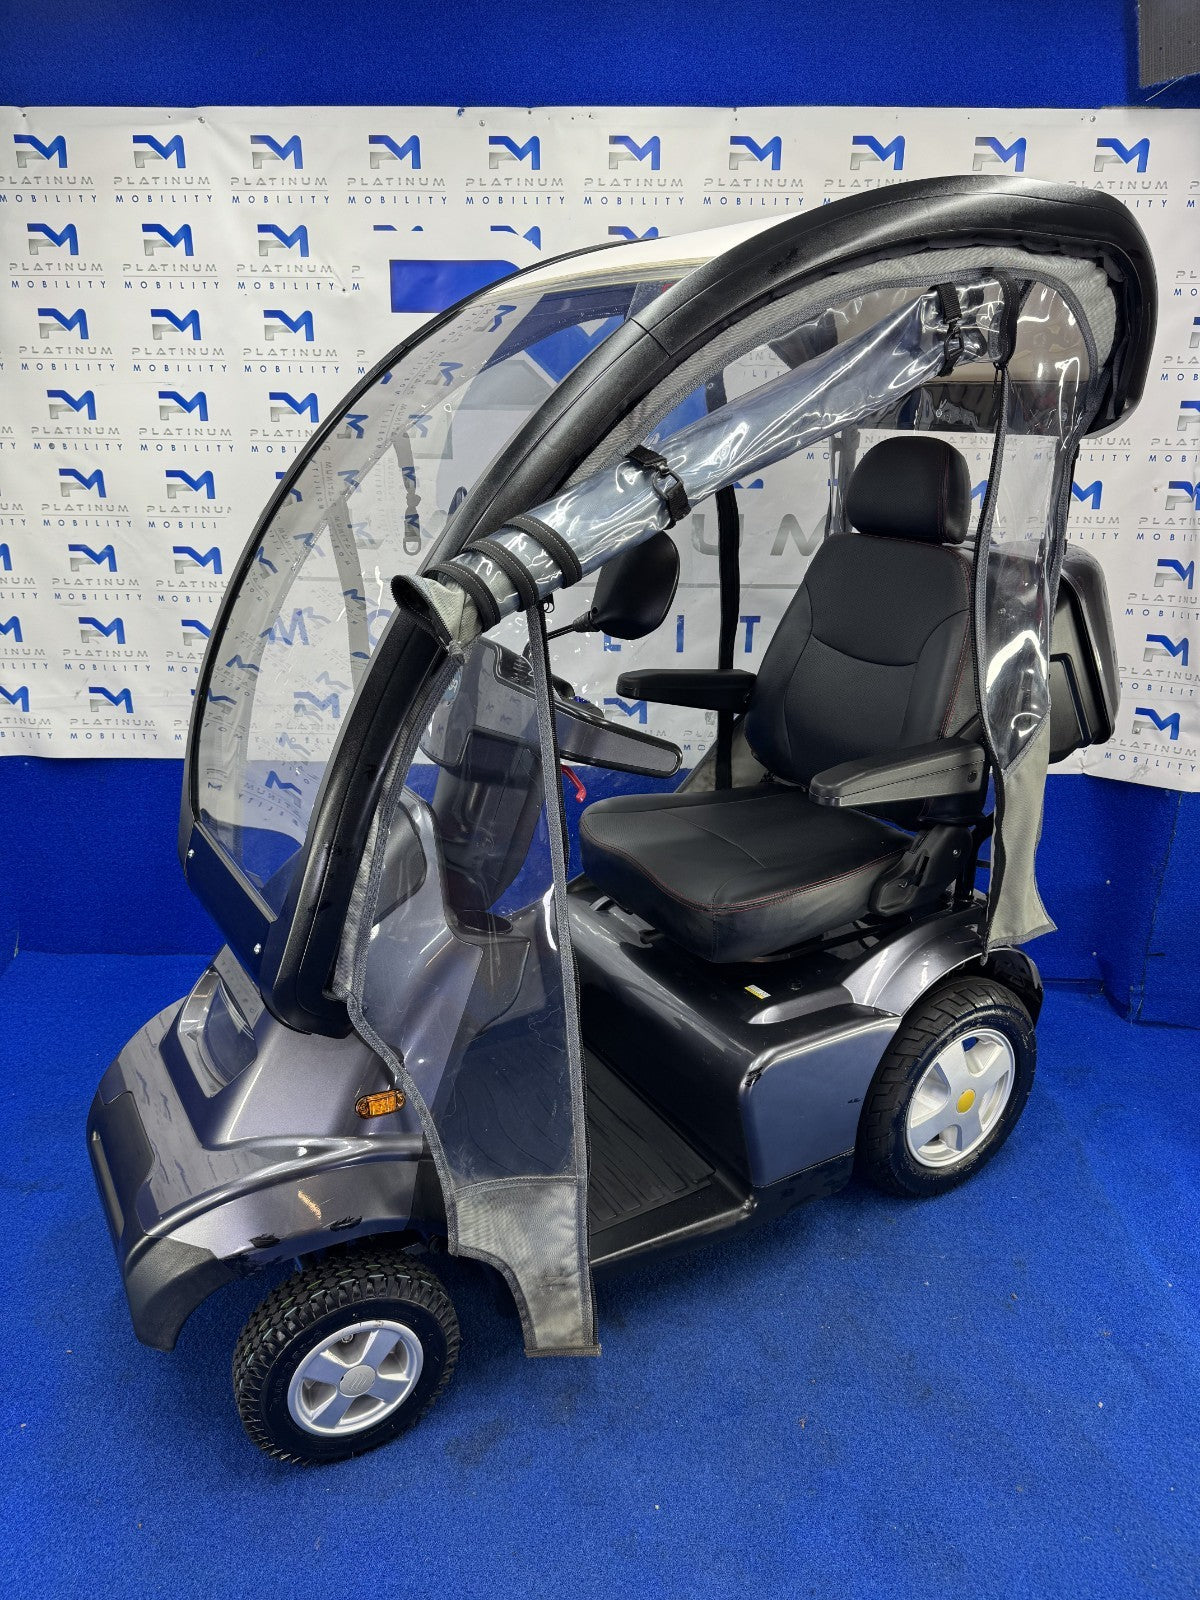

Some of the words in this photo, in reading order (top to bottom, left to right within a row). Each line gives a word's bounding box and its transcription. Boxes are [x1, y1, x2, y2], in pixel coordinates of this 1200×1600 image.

[231, 177, 327, 185] PLATINUM
[348, 177, 445, 186] PLATINUM
[466, 178, 563, 186] PLATINUM
[585, 178, 683, 187] PLATINUM
[704, 178, 803, 187] PLATINUM
[348, 196, 446, 204] MOBILITY
[584, 197, 683, 205] MOBILITY
[703, 197, 803, 205] MOBILITY
[9, 263, 102, 271] PLATINUM
[123, 264, 216, 272] PLATINUM
[237, 264, 332, 273] PLATINUM
[125, 281, 219, 289] MOBILITY
[238, 282, 334, 290] MOBILITY
[19, 346, 112, 354] PLATINUM
[243, 348, 337, 357] PLATINUM
[22, 363, 114, 371] MOBILITY
[134, 364, 226, 372] MOBILITY
[245, 365, 339, 373] MOBILITY
[139, 428, 231, 436] PLATINUM
[250, 429, 313, 438] PLATIN
[1151, 438, 1200, 446] PLAT
[141, 444, 233, 452] MOBILITY
[251, 445, 298, 453] MOBI
[1149, 455, 1198, 463] MOBI
[42, 504, 128, 512] PLATINUM
[148, 521, 216, 529] MOBILI
[52, 578, 139, 586] PLATINUM
[156, 580, 227, 588] PLATINU
[63, 649, 148, 657] PLATINUM
[0, 731, 53, 740] BILITY
[1108, 738, 1196, 756] PLATINUM
[1105, 752, 1196, 771] MOBILITY
